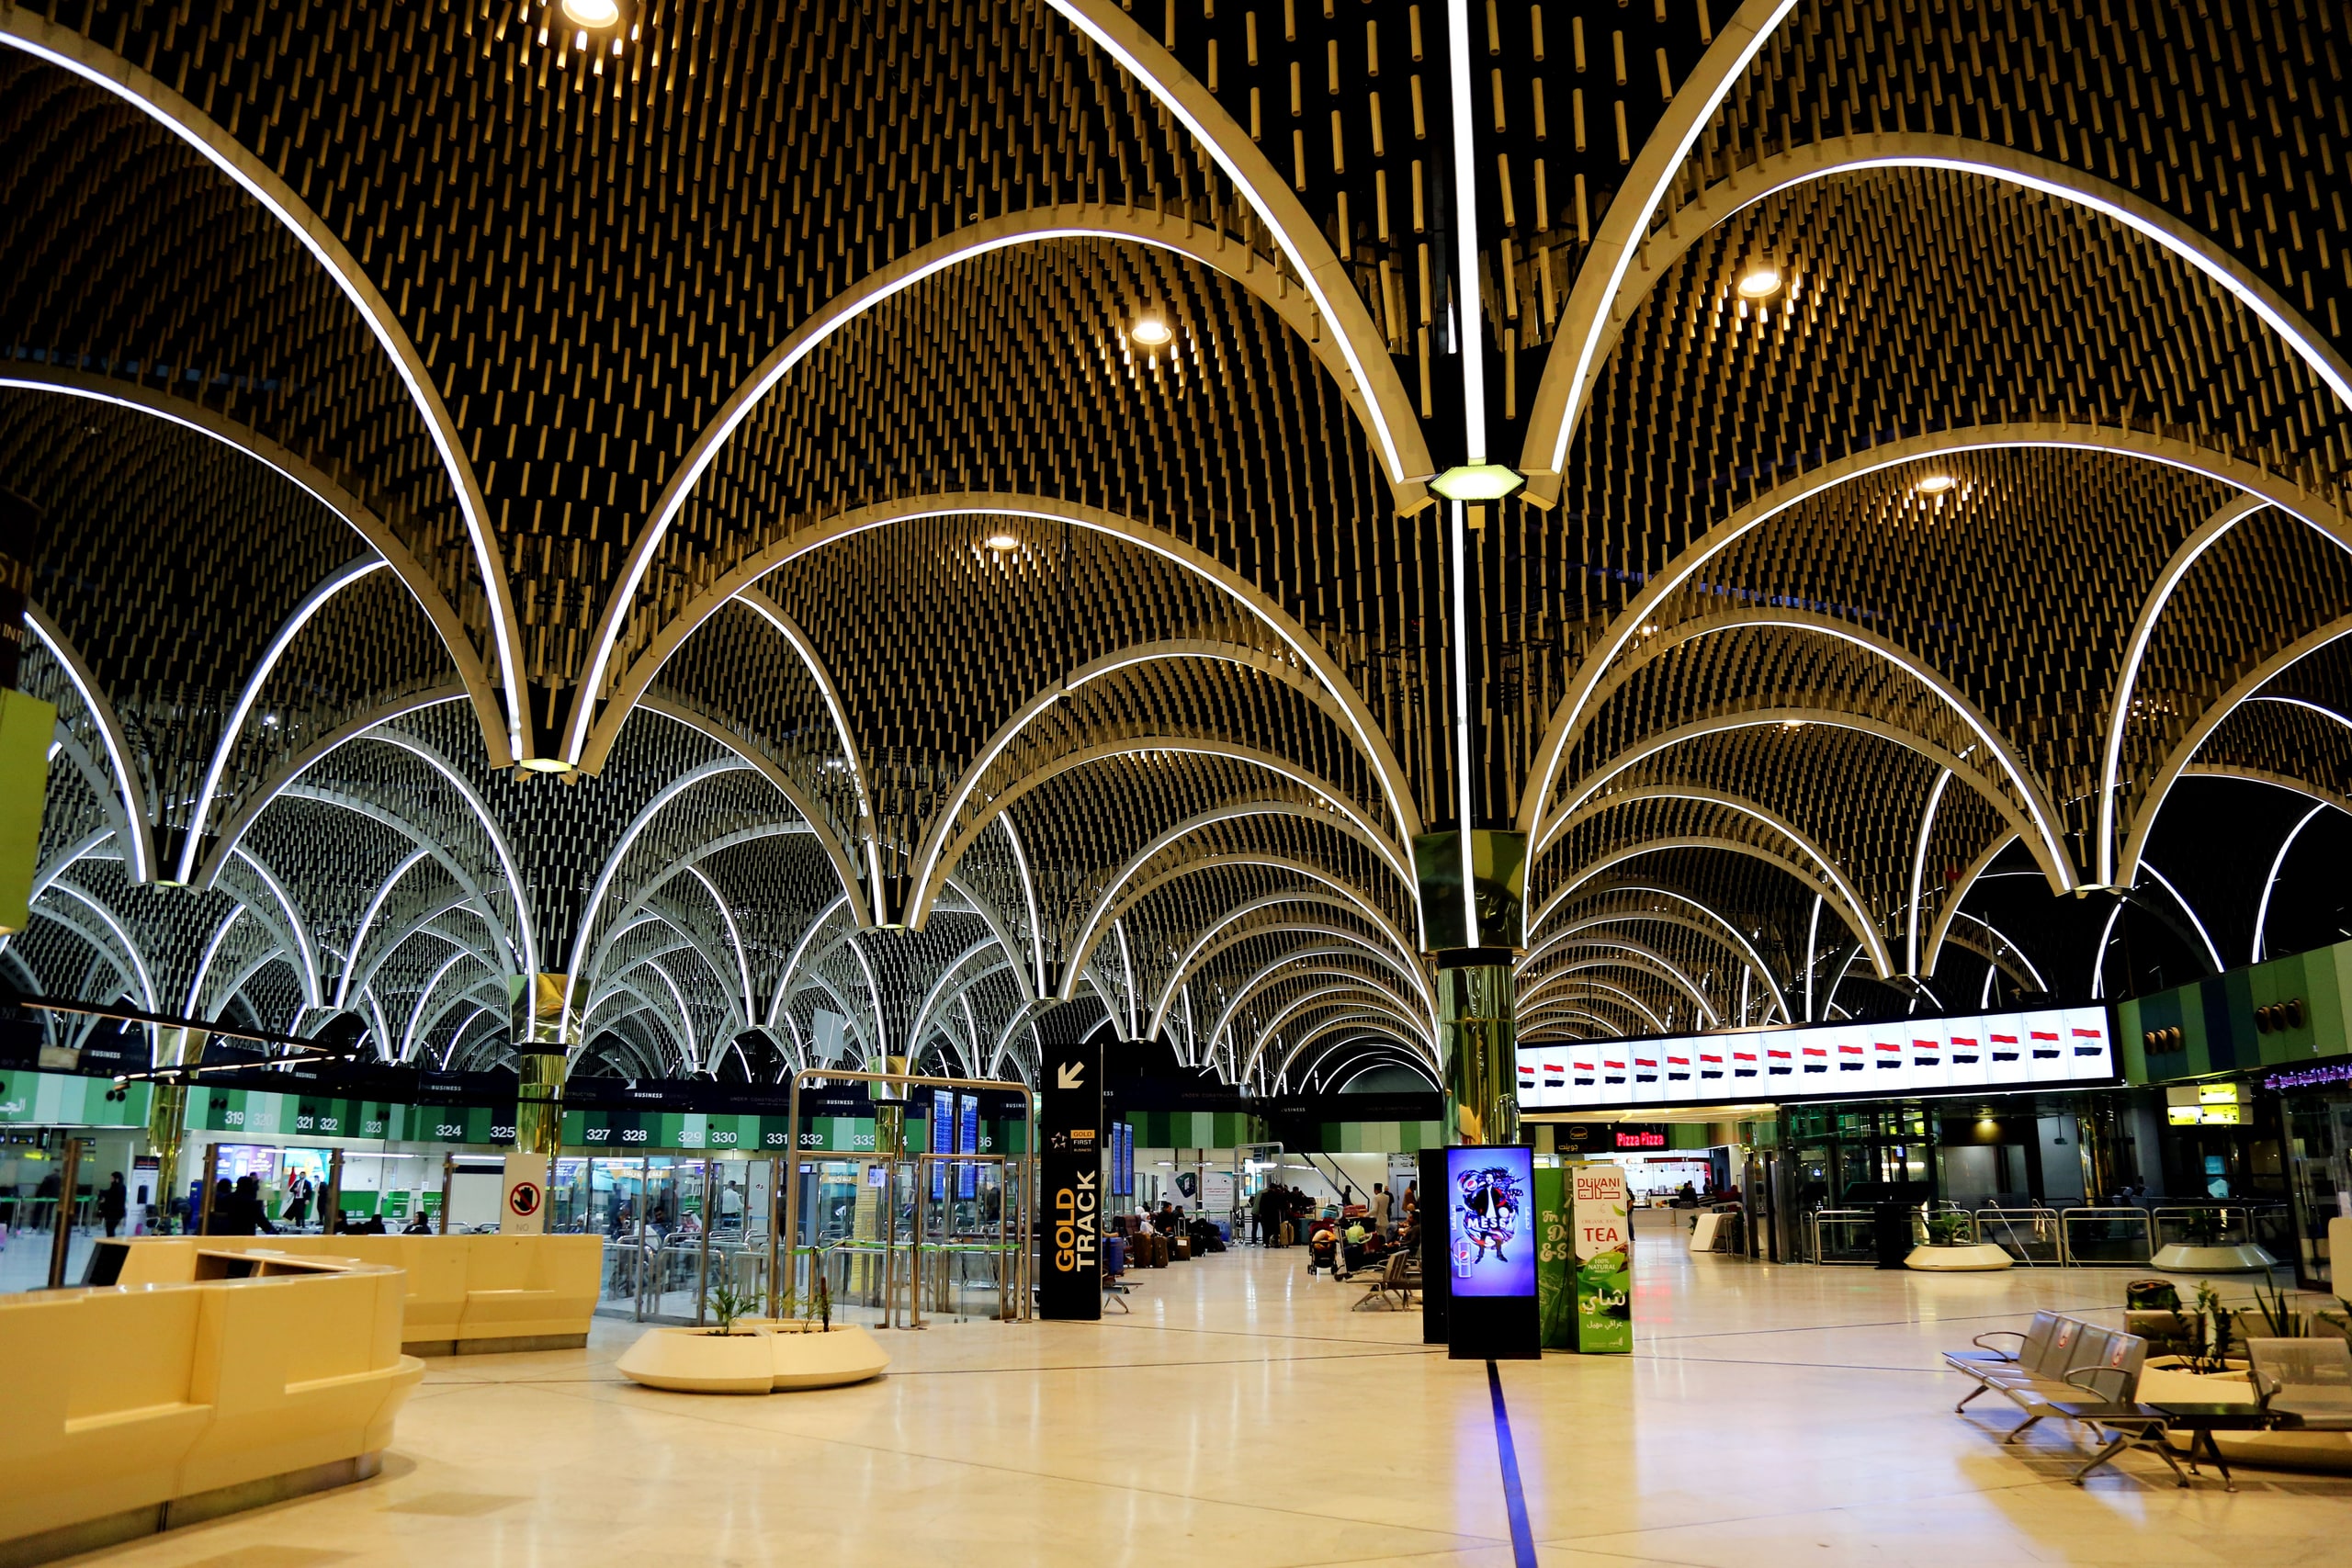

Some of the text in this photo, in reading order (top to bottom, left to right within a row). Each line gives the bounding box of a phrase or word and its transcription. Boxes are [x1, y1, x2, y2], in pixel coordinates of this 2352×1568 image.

[91, 1050, 121, 1059] BUSINESS
[225, 1111, 244, 1125] 319
[296, 1116, 314, 1130] 321
[320, 1117, 338, 1131] 322
[366, 1122, 382, 1134] 323
[435, 1124, 462, 1136] 324
[490, 1126, 515, 1138] 325
[586, 1129, 611, 1141] 327
[622, 1130, 648, 1142] 328
[678, 1131, 702, 1143] 329
[712, 1132, 738, 1144] 330
[766, 1133, 789, 1145] 331
[799, 1134, 824, 1145] 332
[853, 1134, 876, 1146] 333
[1616, 1132, 1665, 1146] Pizza Pizza
[1558, 1143, 1578, 1152] جوينت
[1077, 1170, 1095, 1271] TRACK
[1467, 1217, 1512, 1229] MESSI
[515, 1223, 530, 1232] NO
[1056, 1188, 1075, 1271] GOLD
[1583, 1227, 1618, 1242] TEA
[1582, 1288, 1626, 1314] شاي
